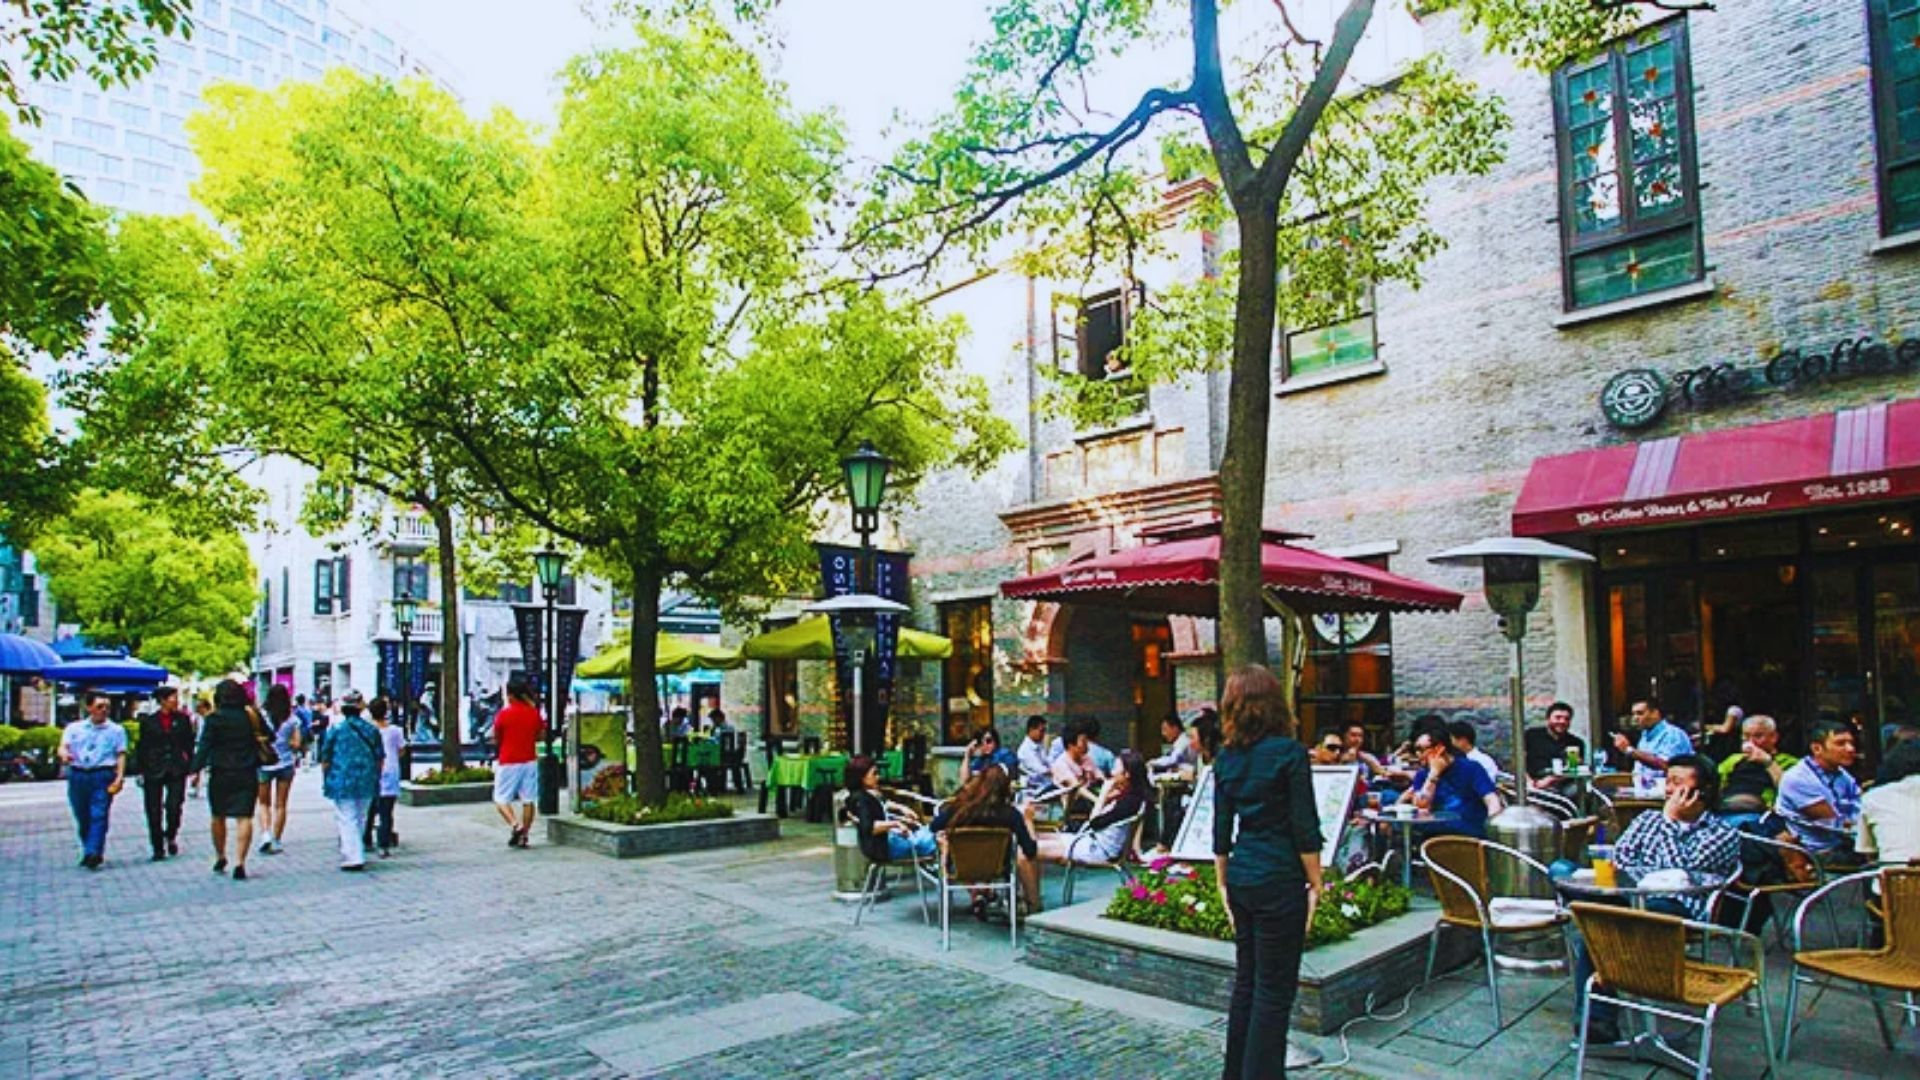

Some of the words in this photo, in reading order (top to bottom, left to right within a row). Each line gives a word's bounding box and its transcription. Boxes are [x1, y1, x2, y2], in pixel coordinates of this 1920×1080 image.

[1576, 511, 1599, 526] The
[1602, 507, 1644, 522] Coffee
[1687, 501, 1699, 513] &
[1729, 491, 1772, 508] Leaf
